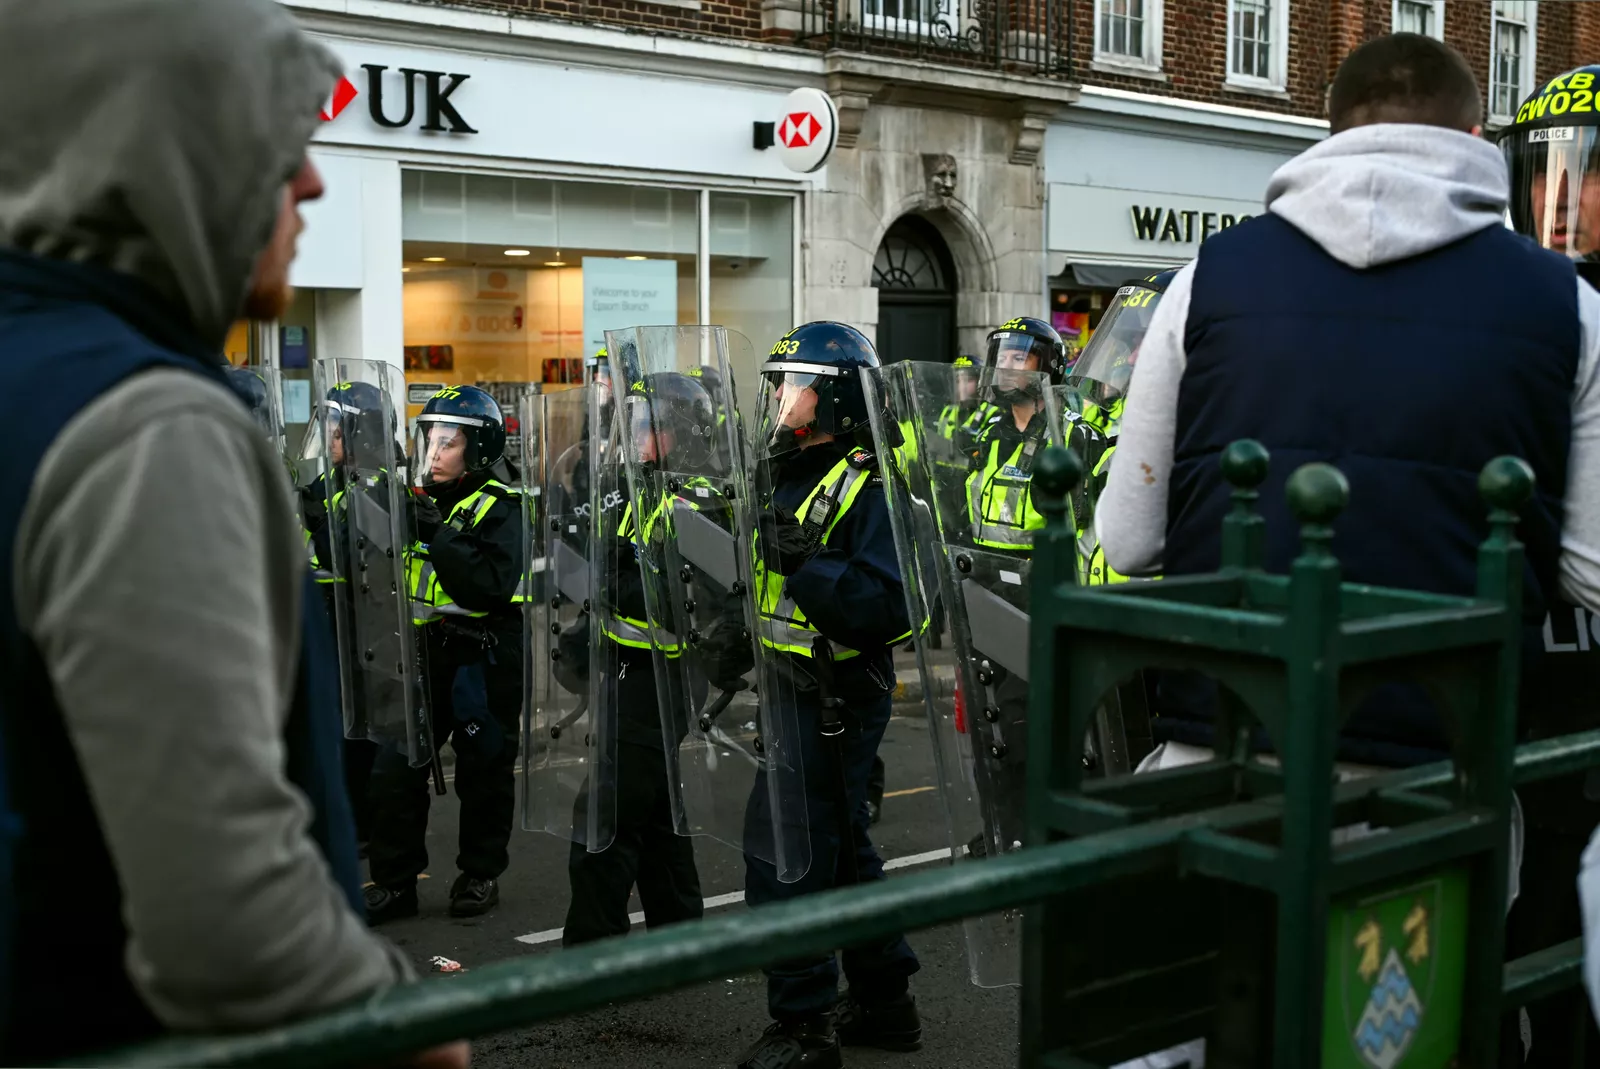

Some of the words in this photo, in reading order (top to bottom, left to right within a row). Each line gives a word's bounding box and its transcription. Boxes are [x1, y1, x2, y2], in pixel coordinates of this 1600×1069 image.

[1544, 73, 1595, 93] KB
[360, 64, 479, 134] UK
[1516, 90, 1600, 123] CW02
[1533, 129, 1567, 140] POLICE
[592, 287, 629, 298] Welcome
[631, 289, 639, 298] to
[641, 290, 658, 299] your
[592, 301, 619, 312] Epsom
[621, 302, 649, 312] Branch
[1542, 607, 1600, 652] LI
